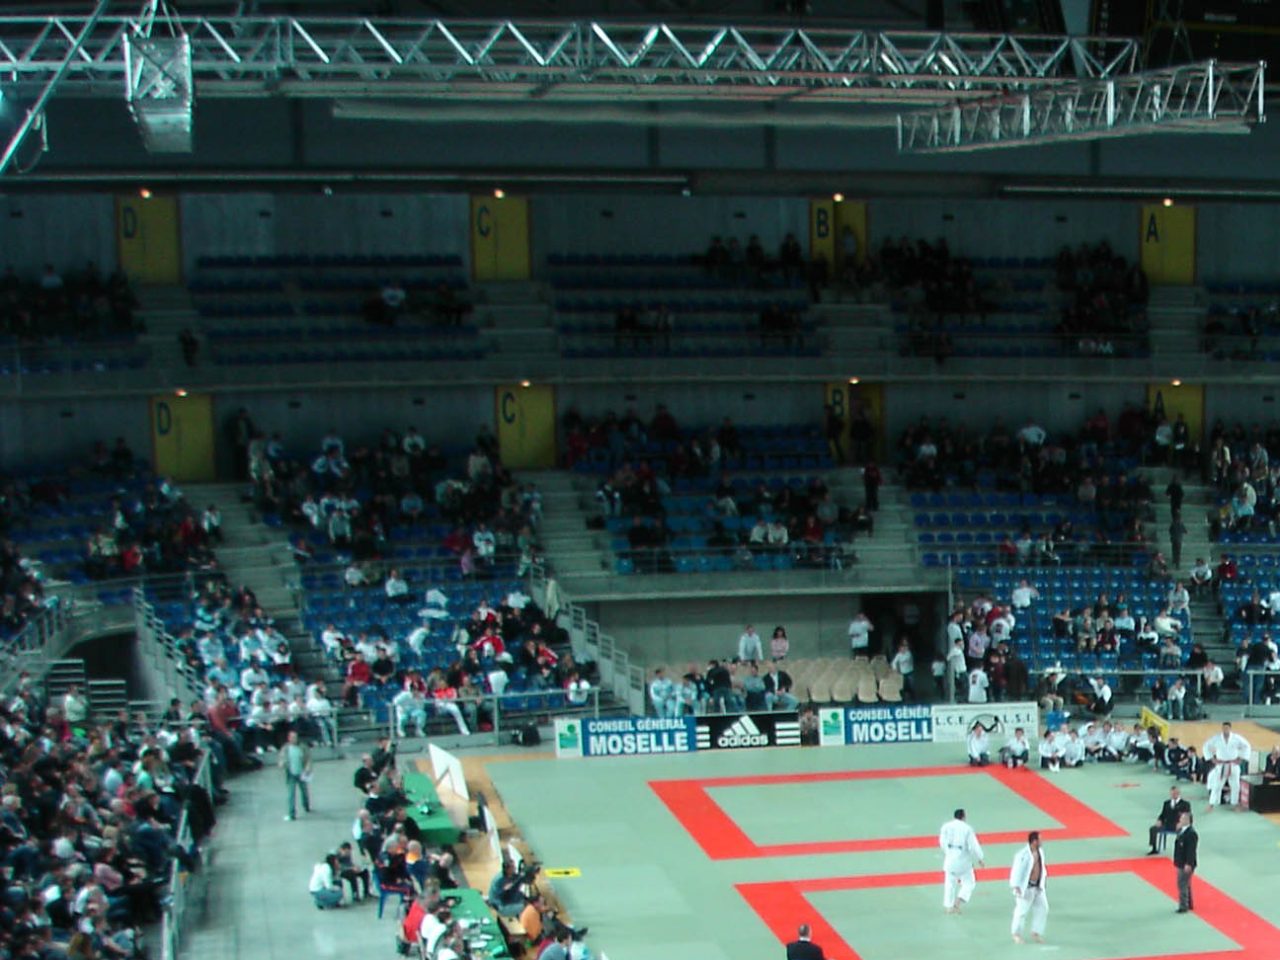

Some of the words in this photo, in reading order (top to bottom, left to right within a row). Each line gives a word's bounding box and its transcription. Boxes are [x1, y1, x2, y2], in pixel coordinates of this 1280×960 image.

[123, 207, 137, 238] D
[477, 205, 490, 237] C
[817, 208, 829, 238] B
[1146, 213, 1159, 243] A
[157, 402, 171, 435] D
[502, 392, 515, 423] C
[589, 720, 635, 733] CONSEIL
[849, 709, 893, 721] CONSEIL
[589, 731, 688, 756] MOSELLE
[717, 733, 769, 747] adidas
[852, 720, 932, 742] MOSELL
